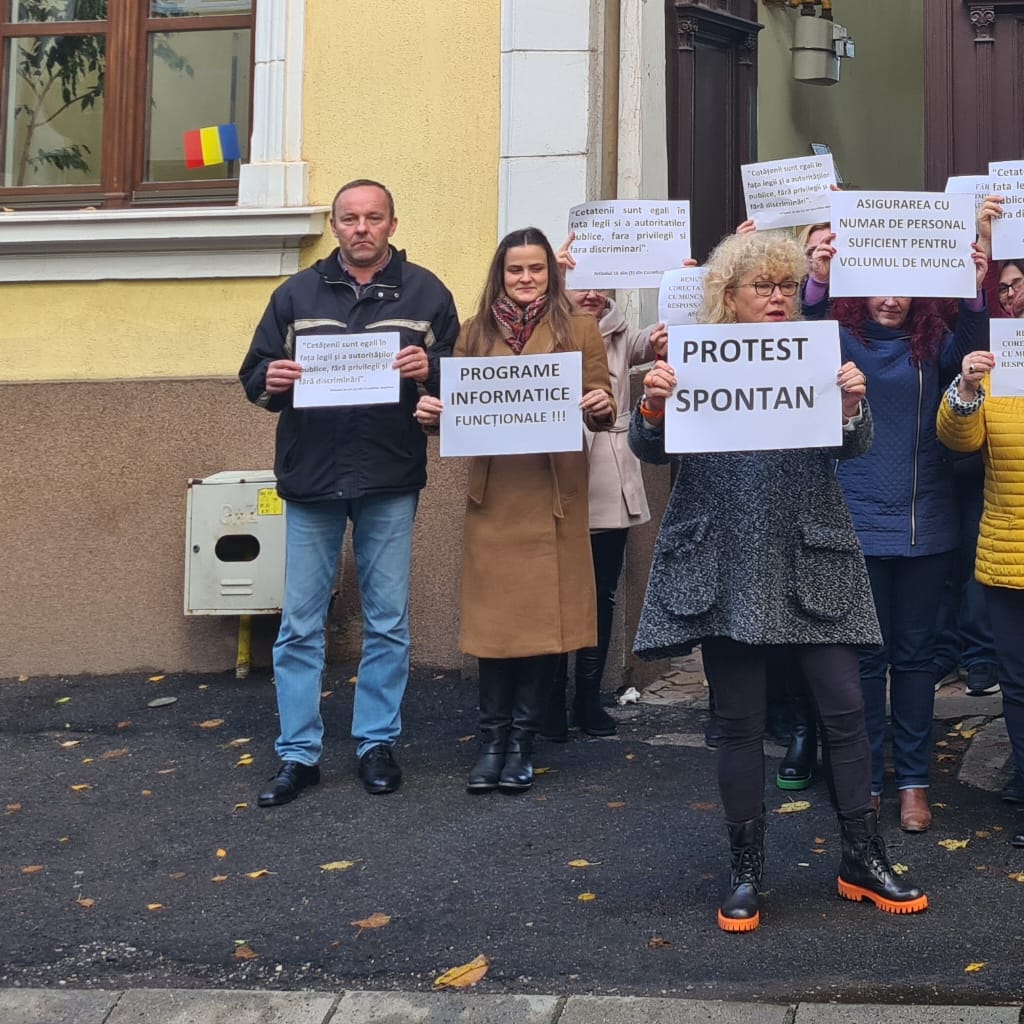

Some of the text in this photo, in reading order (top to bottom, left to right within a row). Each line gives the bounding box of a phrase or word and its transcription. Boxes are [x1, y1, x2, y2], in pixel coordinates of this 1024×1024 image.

[993, 181, 1012, 192] fata
[856, 199, 950, 210] ASIGURAREA CU
[623, 206, 642, 215] sunt
[650, 206, 670, 216] egali
[571, 219, 686, 230] fata legii si a autoritatilor
[839, 218, 967, 230] NUMAR DE PERSONAL
[612, 232, 686, 241] fara privilegii si
[848, 237, 957, 249] SUFICIENT PENTRU
[570, 244, 649, 254] fara discriminari".
[840, 256, 966, 268] VOLUMUL DE MUNCA
[342, 340, 359, 348] sunt
[360, 338, 378, 348] egali
[682, 338, 809, 364] PROTEST
[1002, 350, 1014, 358] CU
[316, 353, 332, 362] legii
[331, 364, 346, 372] fără
[460, 363, 561, 381] PROGRAME
[450, 386, 570, 406] INFORMATICE
[676, 385, 814, 413] SPONTAN
[455, 410, 566, 428] FUNCȚIONALE !!!
